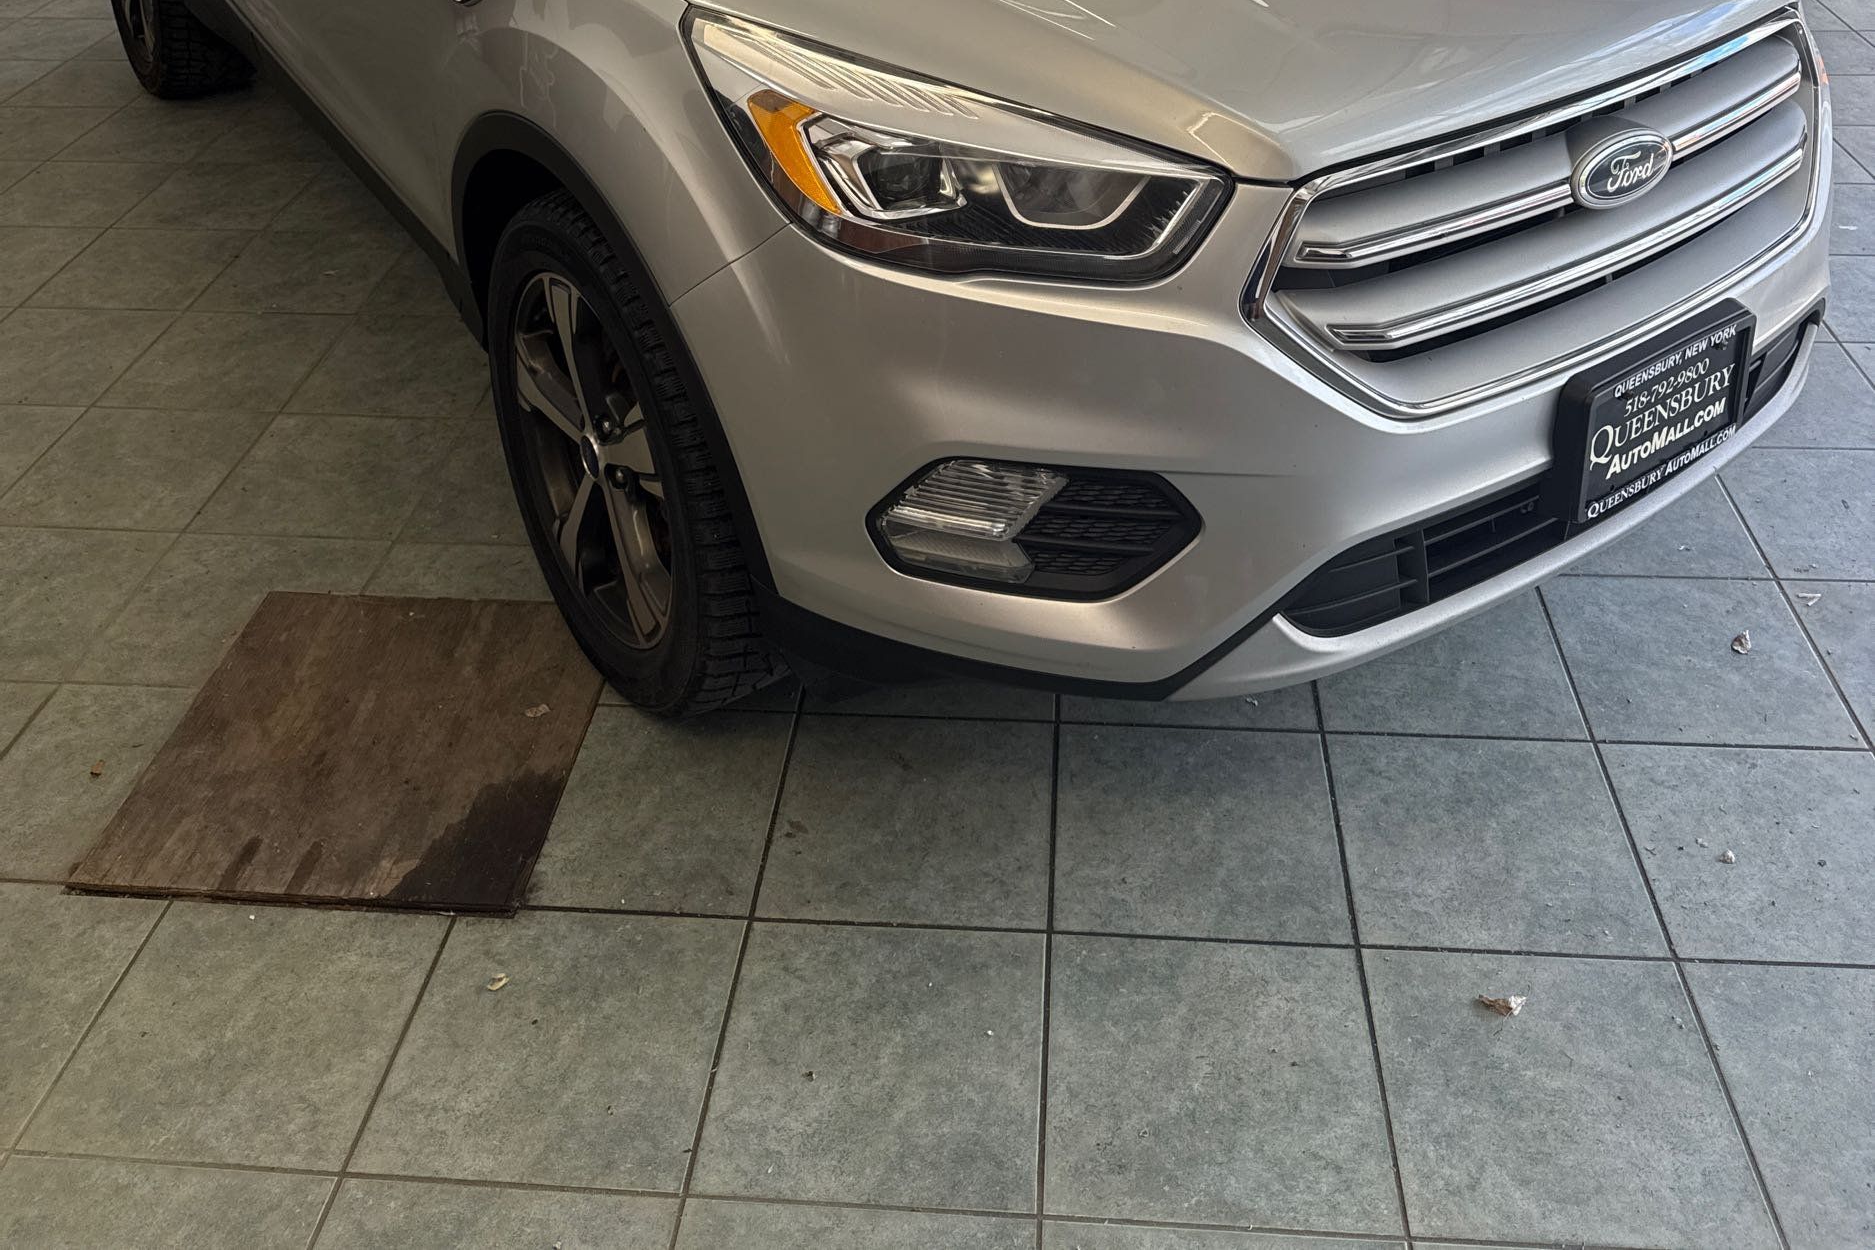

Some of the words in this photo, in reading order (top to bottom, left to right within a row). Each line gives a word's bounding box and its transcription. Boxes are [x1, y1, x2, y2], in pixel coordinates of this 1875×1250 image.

[1607, 150, 1654, 193] Ford
[1614, 351, 1682, 398] QUEENSBURY,
[1684, 340, 1708, 360] NEW
[1710, 324, 1738, 347] YORK
[1623, 357, 1710, 417] 518-792-9800
[1589, 364, 1735, 471] QUEENSBURY
[1605, 398, 1726, 480] AUTOMALL.COM
[1587, 463, 1667, 519] QUEENSBURY
[1665, 424, 1737, 476] AUTOMALL.COM
